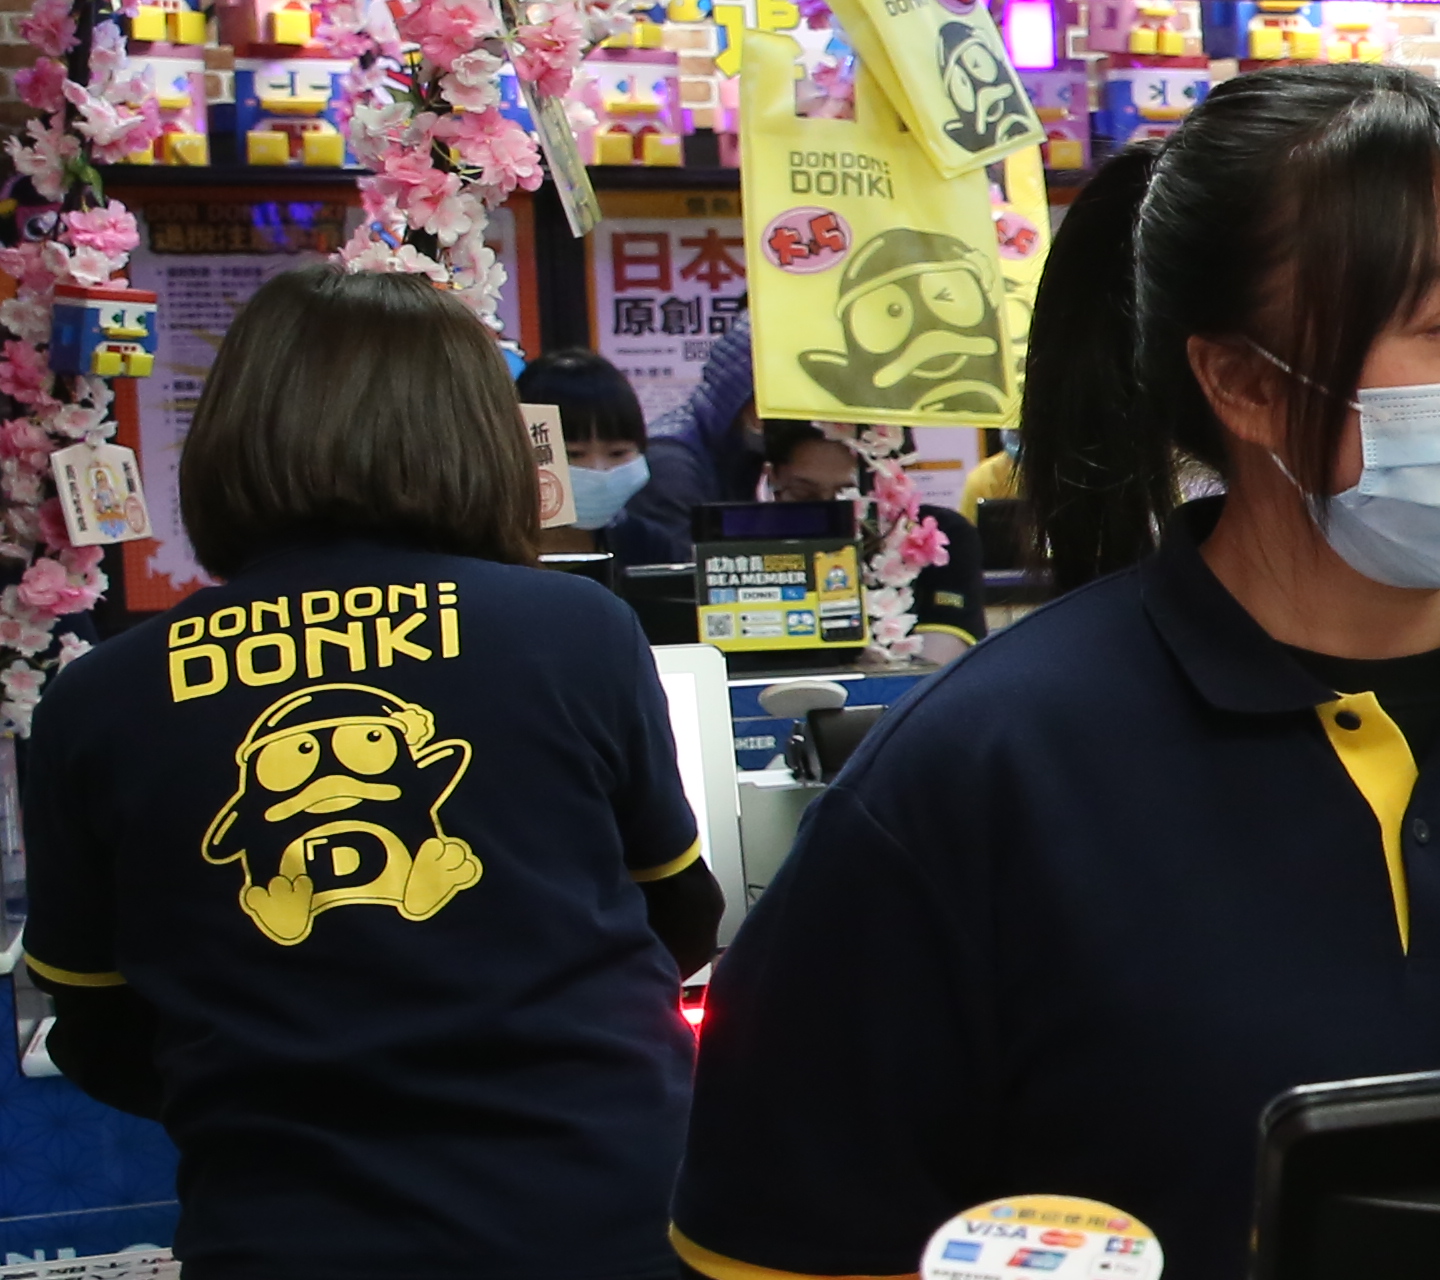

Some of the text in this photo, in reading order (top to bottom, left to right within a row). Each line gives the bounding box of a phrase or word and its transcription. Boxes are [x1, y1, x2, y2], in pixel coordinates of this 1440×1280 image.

[791, 169, 895, 200] DONKI
[612, 228, 746, 293] 日本
[741, 571, 808, 586] MEMBER
[167, 606, 462, 704] DONKI
[965, 1220, 1028, 1240] VISA
